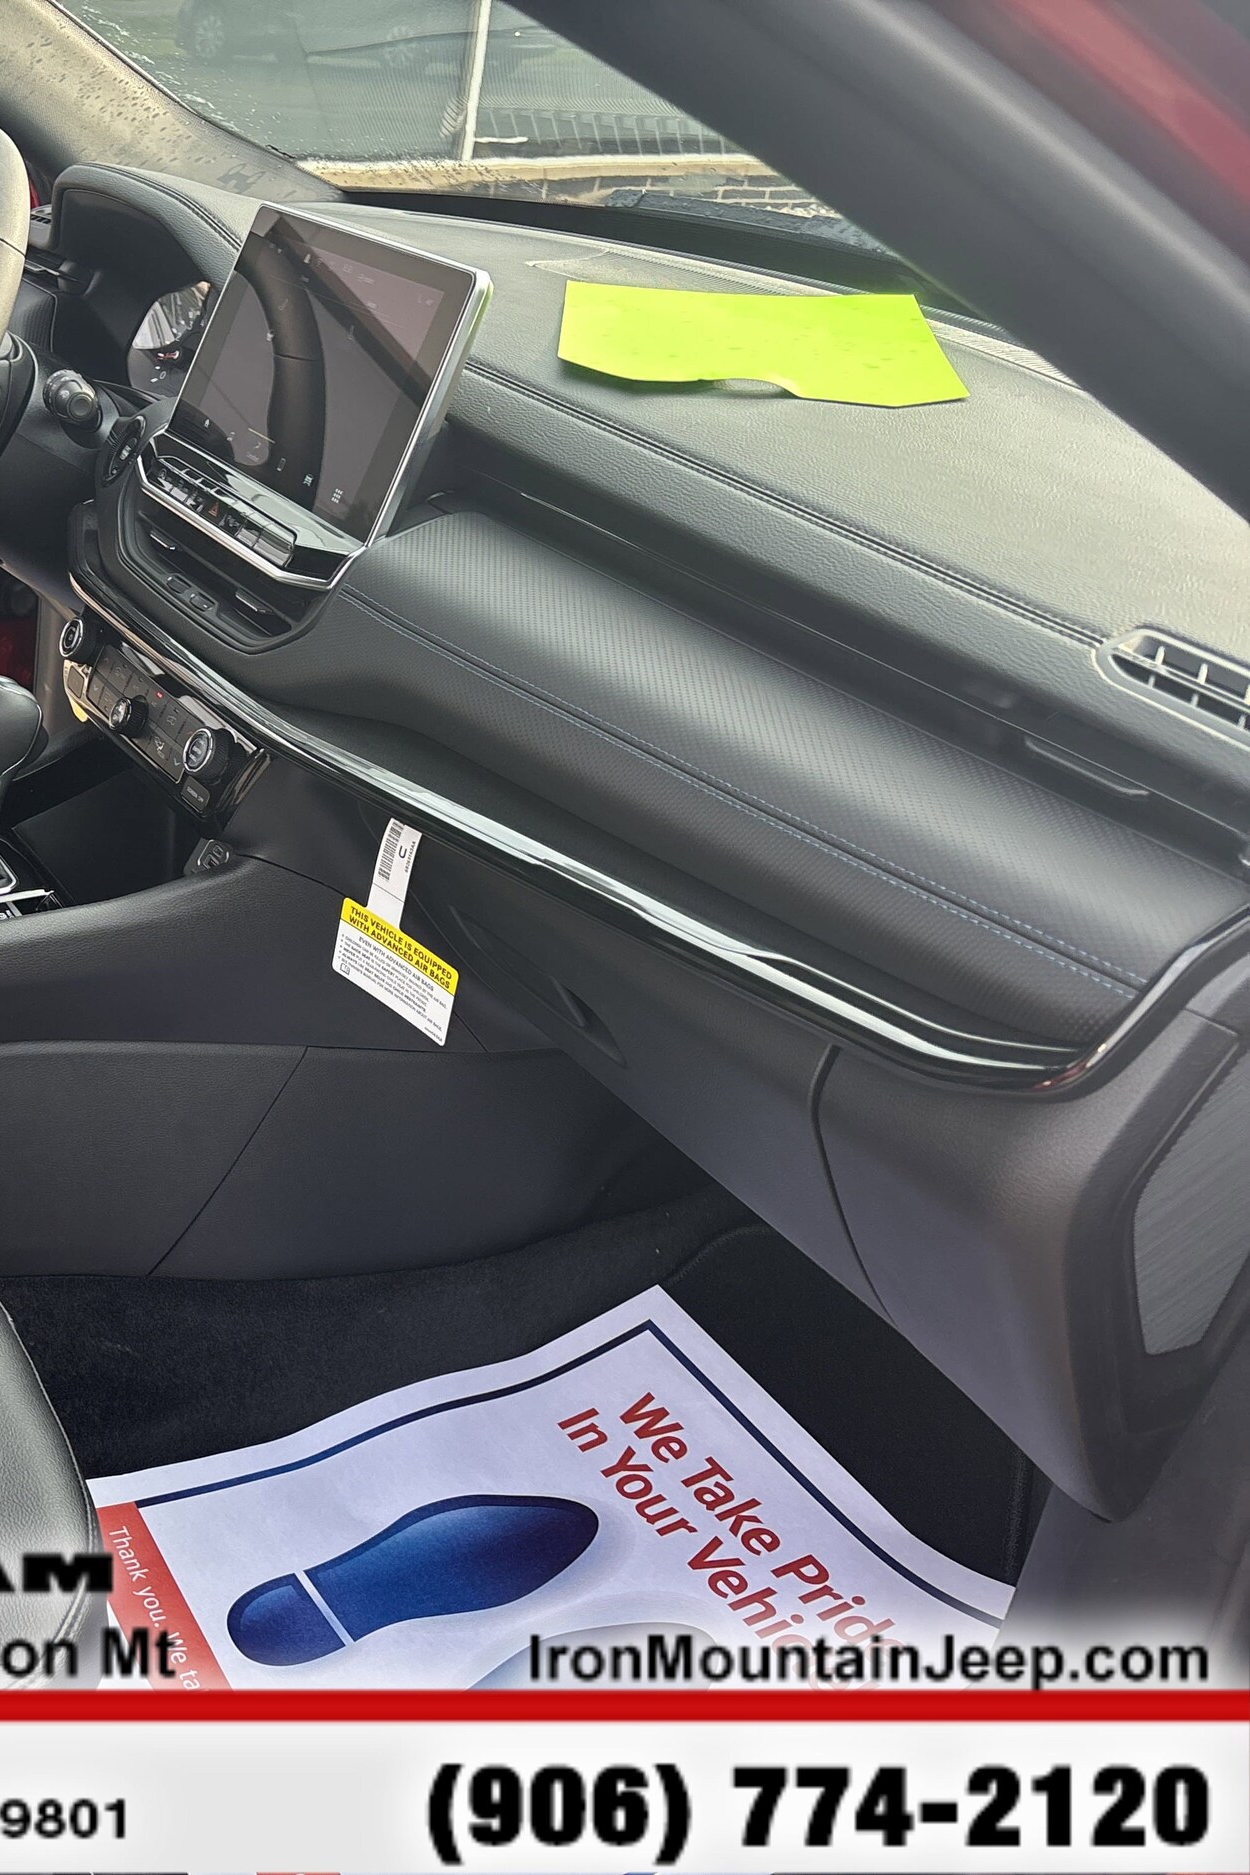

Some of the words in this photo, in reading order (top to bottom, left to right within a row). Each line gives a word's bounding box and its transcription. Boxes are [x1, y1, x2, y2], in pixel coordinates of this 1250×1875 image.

[348, 915, 369, 932] WITH
[370, 929, 413, 962] ADVANCED
[414, 958, 428, 972] AIR
[428, 969, 450, 988] BAGS
[350, 906, 368, 923] THIS
[369, 918, 403, 945] VEHICLE
[404, 941, 412, 951] IS
[413, 947, 452, 979] EQUIPPED
[358, 936, 371, 947] EVEN
[372, 945, 385, 956] WITH
[385, 954, 412, 974] ADVANCED
[420, 979, 434, 990] BAGS
[557, 1407, 609, 1453] In
[600, 1445, 698, 1538] Your
[619, 1391, 688, 1464] We
[680, 1456, 781, 1556] Take
[108, 1525, 150, 1582] Thank
[132, 1585, 168, 1628] you.
